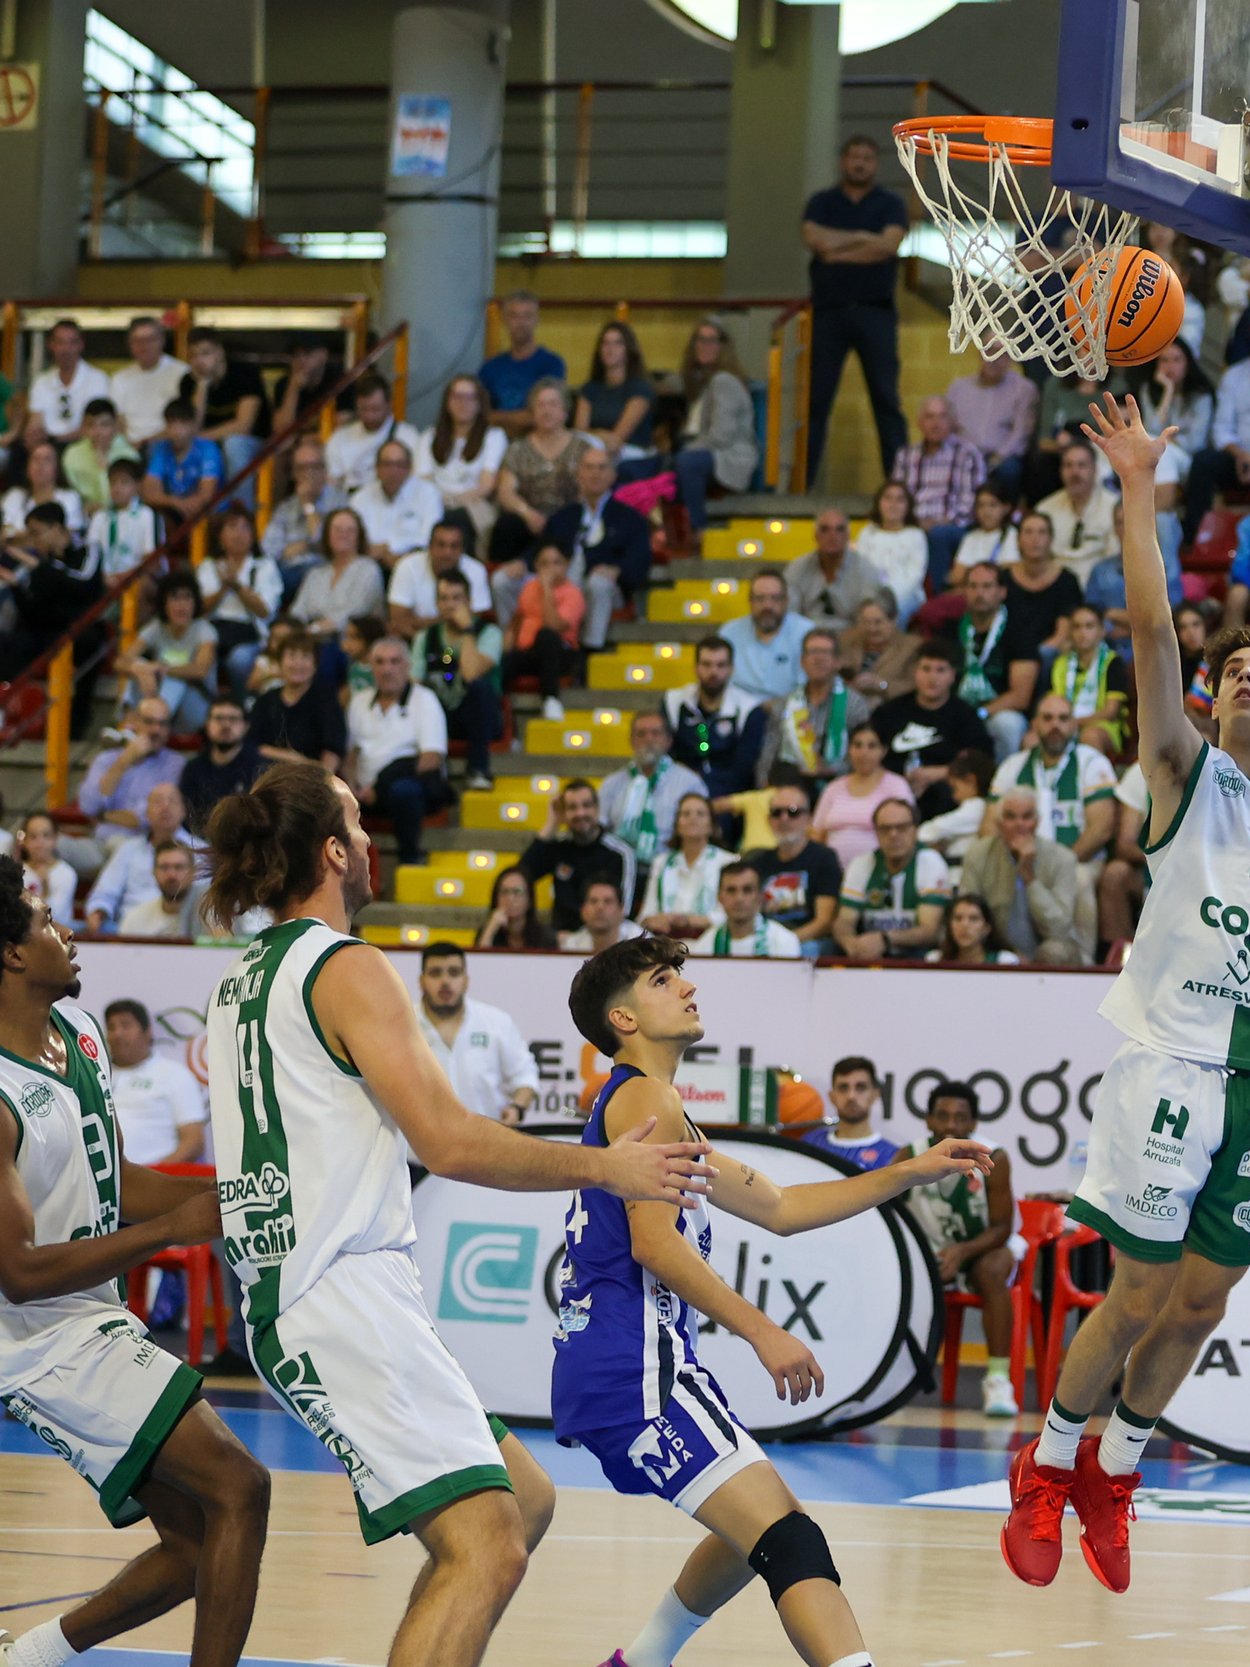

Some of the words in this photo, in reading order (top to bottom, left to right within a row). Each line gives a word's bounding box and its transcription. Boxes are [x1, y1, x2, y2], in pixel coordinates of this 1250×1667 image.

[1117, 258, 1162, 328] Wilson
[1146, 1136, 1185, 1156] Hospital
[1142, 1148, 1182, 1167] Arruzafa
[1125, 1194, 1188, 1217] IMDECO
